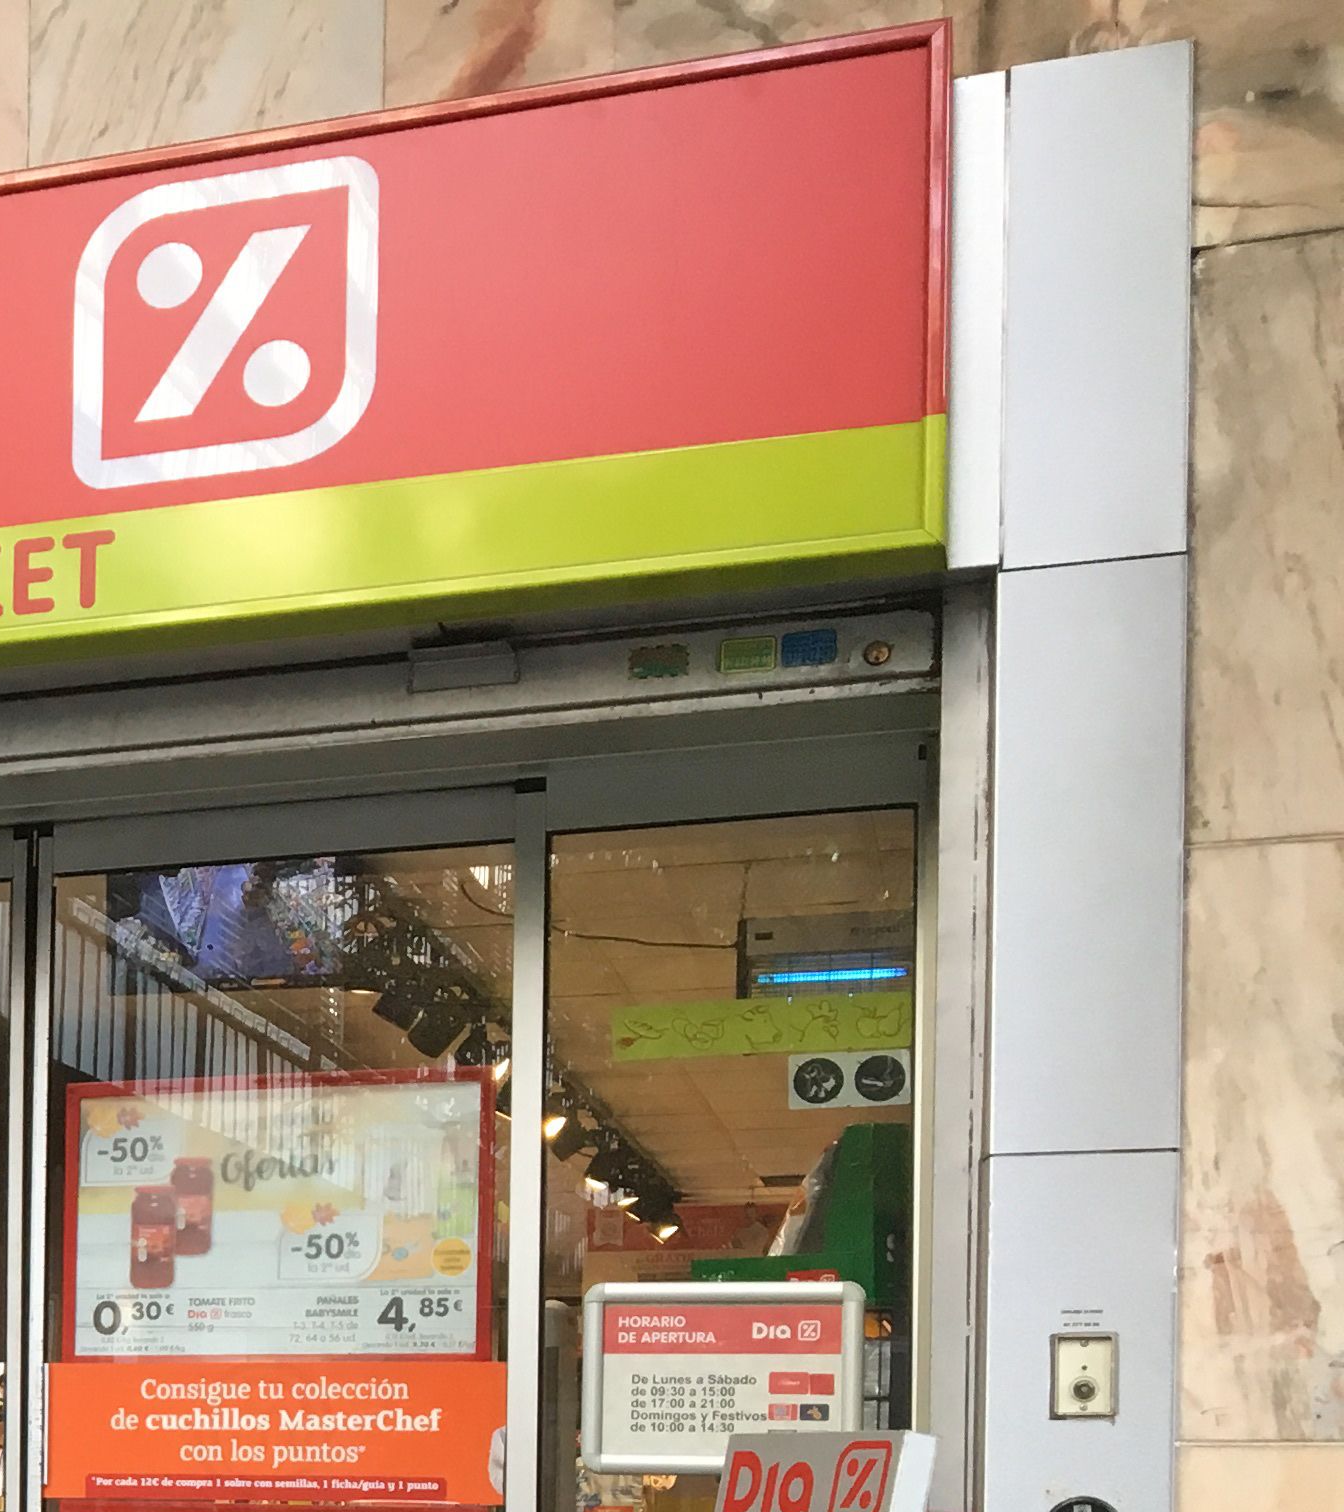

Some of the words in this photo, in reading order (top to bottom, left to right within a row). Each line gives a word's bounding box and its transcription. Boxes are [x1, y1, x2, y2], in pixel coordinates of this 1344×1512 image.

[188, 1298, 226, 1306] TOMATE
[228, 1297, 255, 1306] FRITO
[454, 1300, 463, 1311] €
[166, 1303, 175, 1315] €
[618, 1316, 686, 1328] HORARIO
[618, 1332, 636, 1343] DE
[641, 1332, 716, 1343] APERTURA
[632, 1374, 648, 1385] De
[652, 1374, 692, 1385] Lunes
[696, 1377, 704, 1385] a
[708, 1374, 757, 1385] Sábado
[140, 1378, 251, 1405] Consigue
[258, 1379, 284, 1400] tu
[292, 1377, 409, 1401] colección
[631, 1386, 647, 1397] de
[650, 1387, 685, 1397] 09:30
[689, 1389, 697, 1397] a
[701, 1387, 736, 1397] 15:00
[631, 1398, 647, 1409] de
[651, 1399, 685, 1409] 17:00
[689, 1401, 697, 1409] a
[701, 1399, 736, 1409] 21:00
[110, 1408, 139, 1431] de
[145, 1407, 270, 1432] cuchillos
[279, 1408, 443, 1432] MasterChef
[631, 1410, 696, 1423] Domingos
[701, 1413, 708, 1423] y
[712, 1410, 767, 1421] Festivos
[630, 1422, 646, 1432] de
[650, 1422, 685, 1432] 10:00
[701, 1422, 735, 1432] 14:30
[180, 1440, 222, 1461] con
[230, 1440, 265, 1461] los
